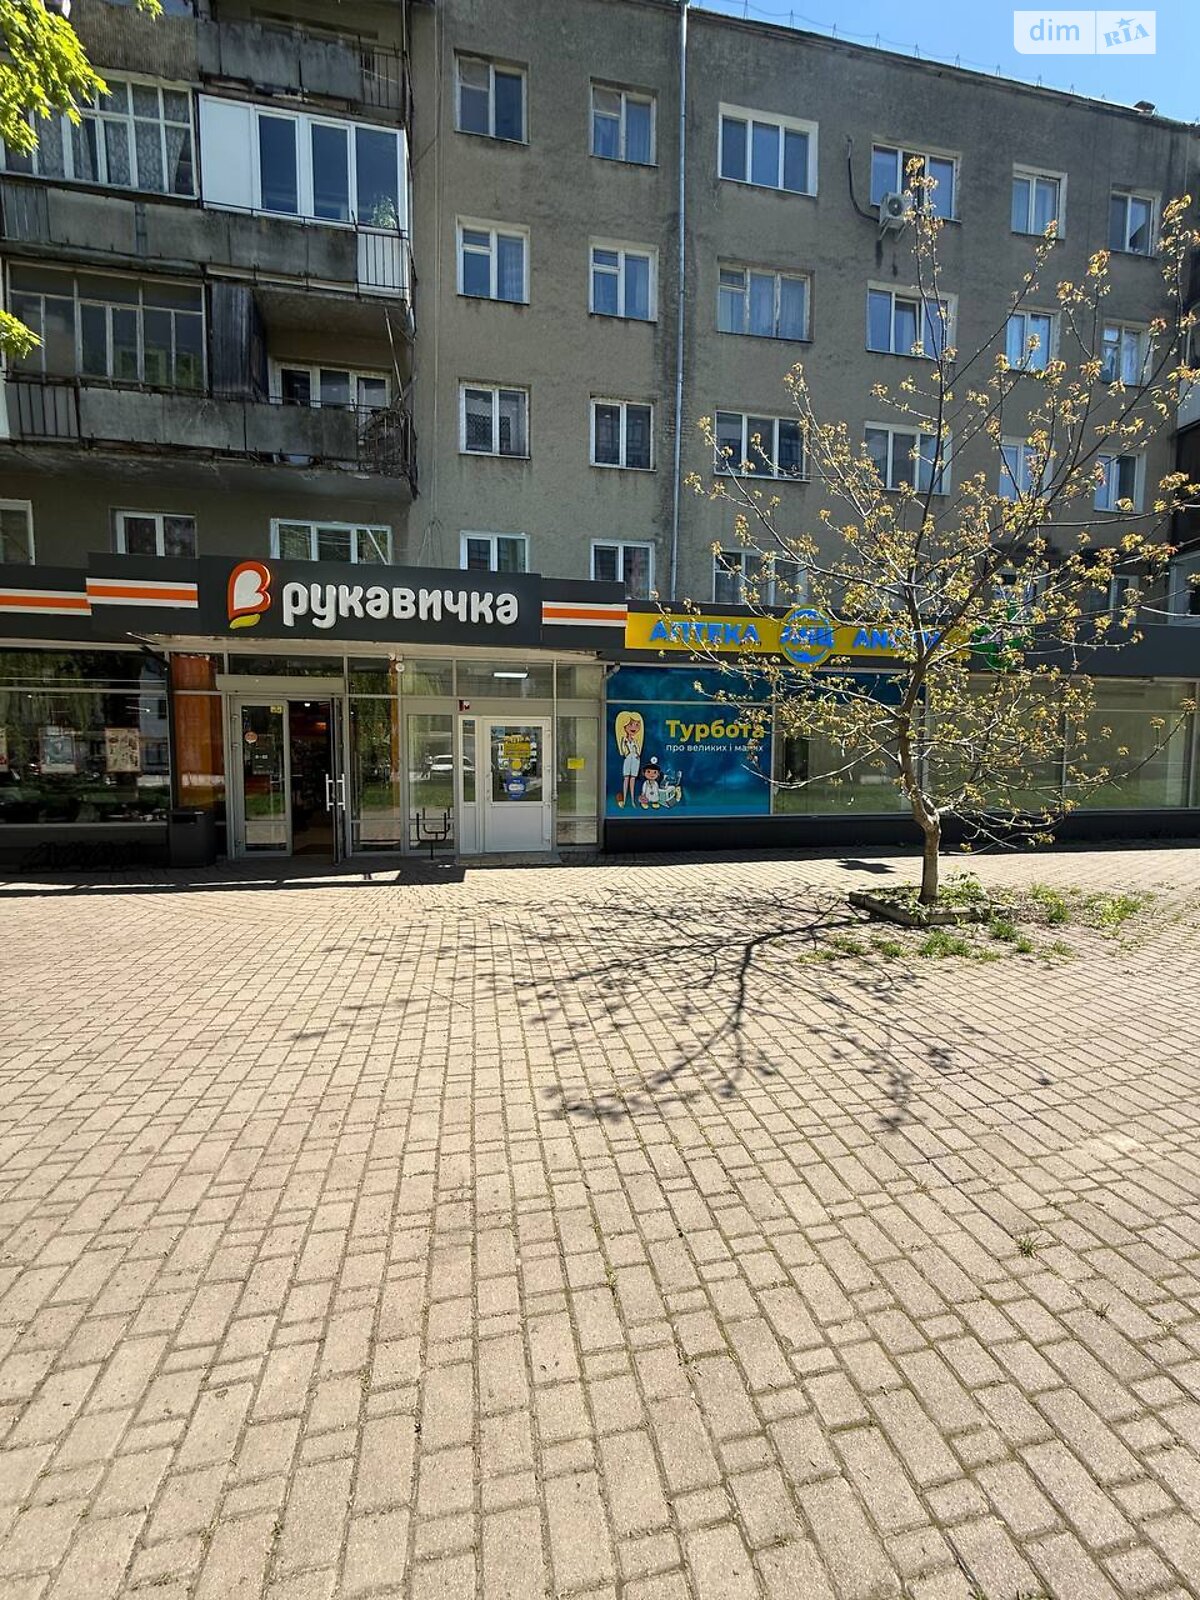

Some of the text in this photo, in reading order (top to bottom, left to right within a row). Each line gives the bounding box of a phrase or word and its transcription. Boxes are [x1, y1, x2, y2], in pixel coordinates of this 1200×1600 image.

[282, 581, 520, 630] рукавичка
[649, 619, 762, 646] АПТЕКА
[665, 719, 765, 742] Турбота
[665, 744, 686, 752] про
[687, 744, 727, 752] великих
[734, 744, 764, 752] маих
